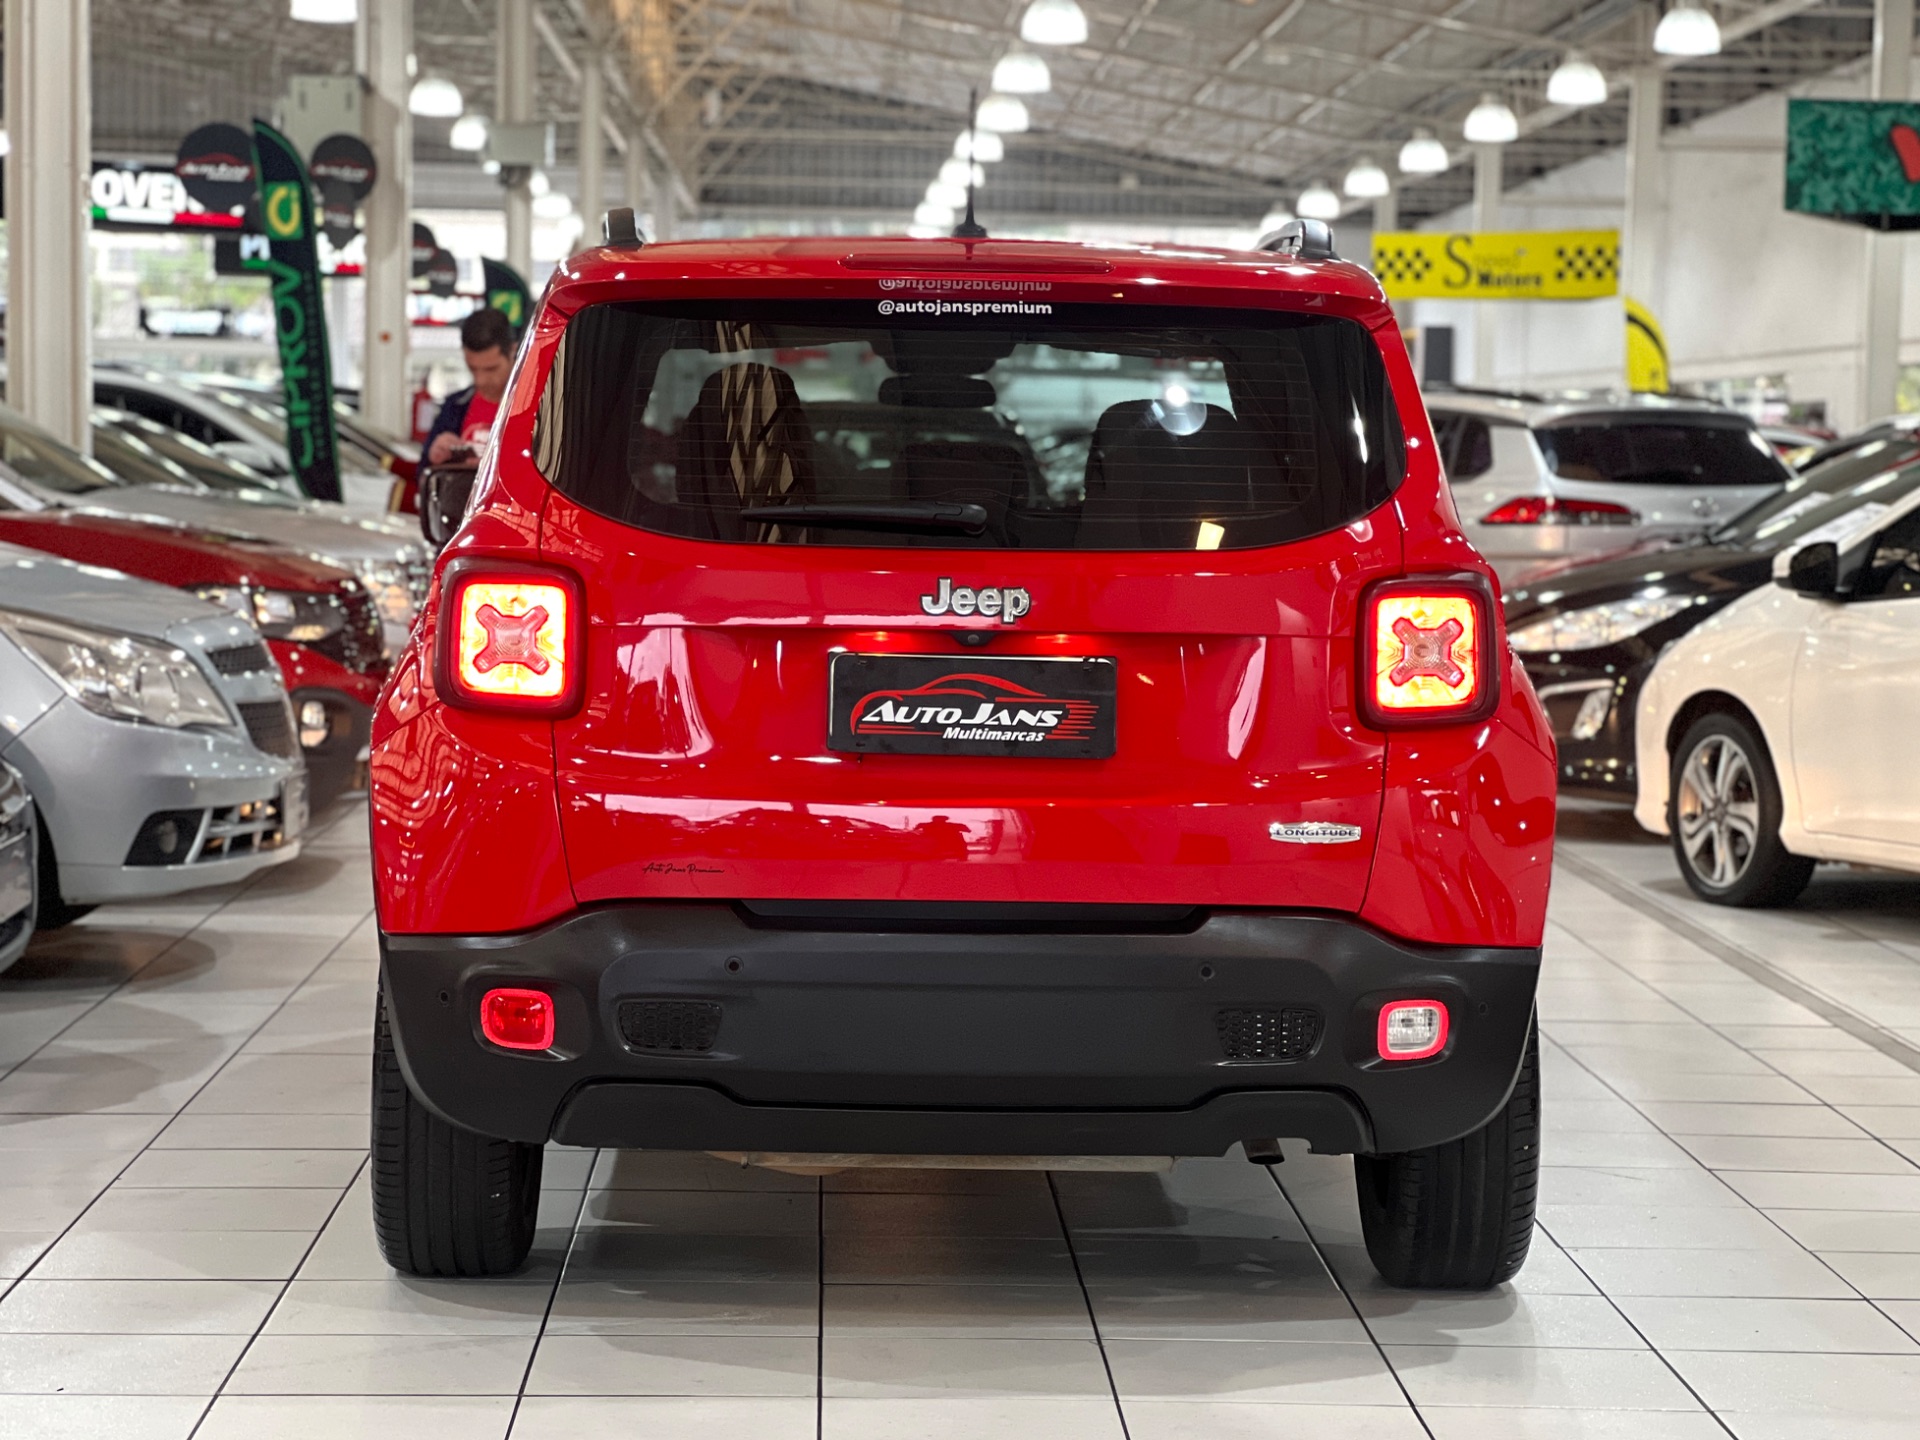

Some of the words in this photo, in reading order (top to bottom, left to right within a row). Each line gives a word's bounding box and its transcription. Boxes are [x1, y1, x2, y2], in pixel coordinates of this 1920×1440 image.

[877, 299, 1053, 316] @autojanspremium
[920, 577, 1031, 624] Jeep
[942, 726, 1046, 742] Multimarcas
[1275, 828, 1356, 837] LONGITUDE
